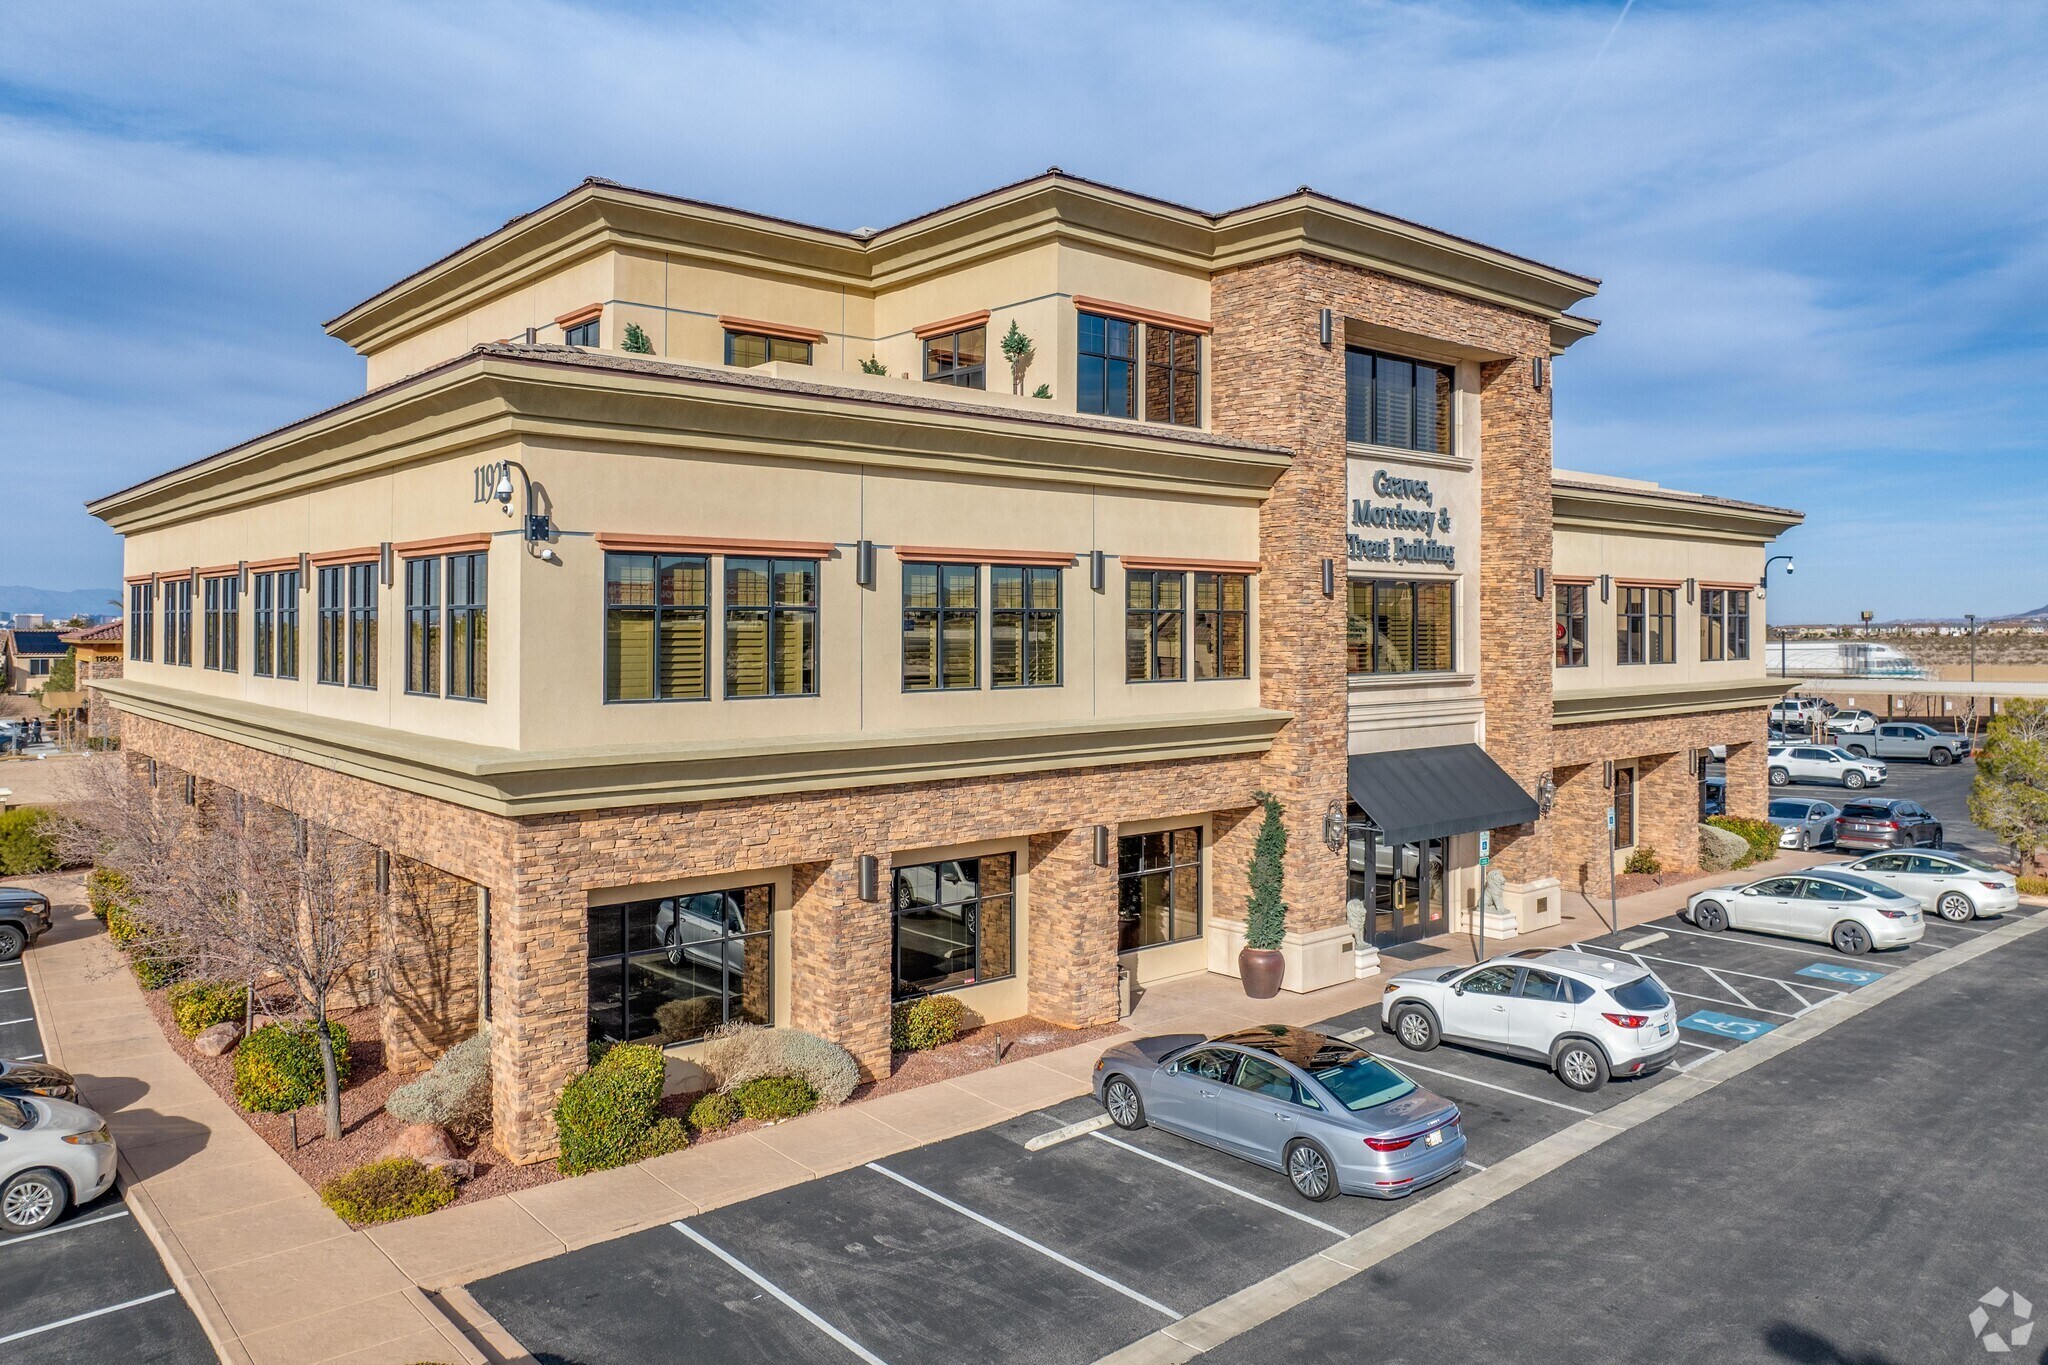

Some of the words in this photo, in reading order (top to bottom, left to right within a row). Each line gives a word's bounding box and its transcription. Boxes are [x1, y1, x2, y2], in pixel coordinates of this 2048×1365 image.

[473, 461, 511, 504] 1192
[1372, 469, 1433, 508] Graves,
[1352, 499, 1436, 538] Morrissey
[1438, 507, 1451, 533] &
[1346, 533, 1390, 562] Trent
[1393, 537, 1455, 571] Building
